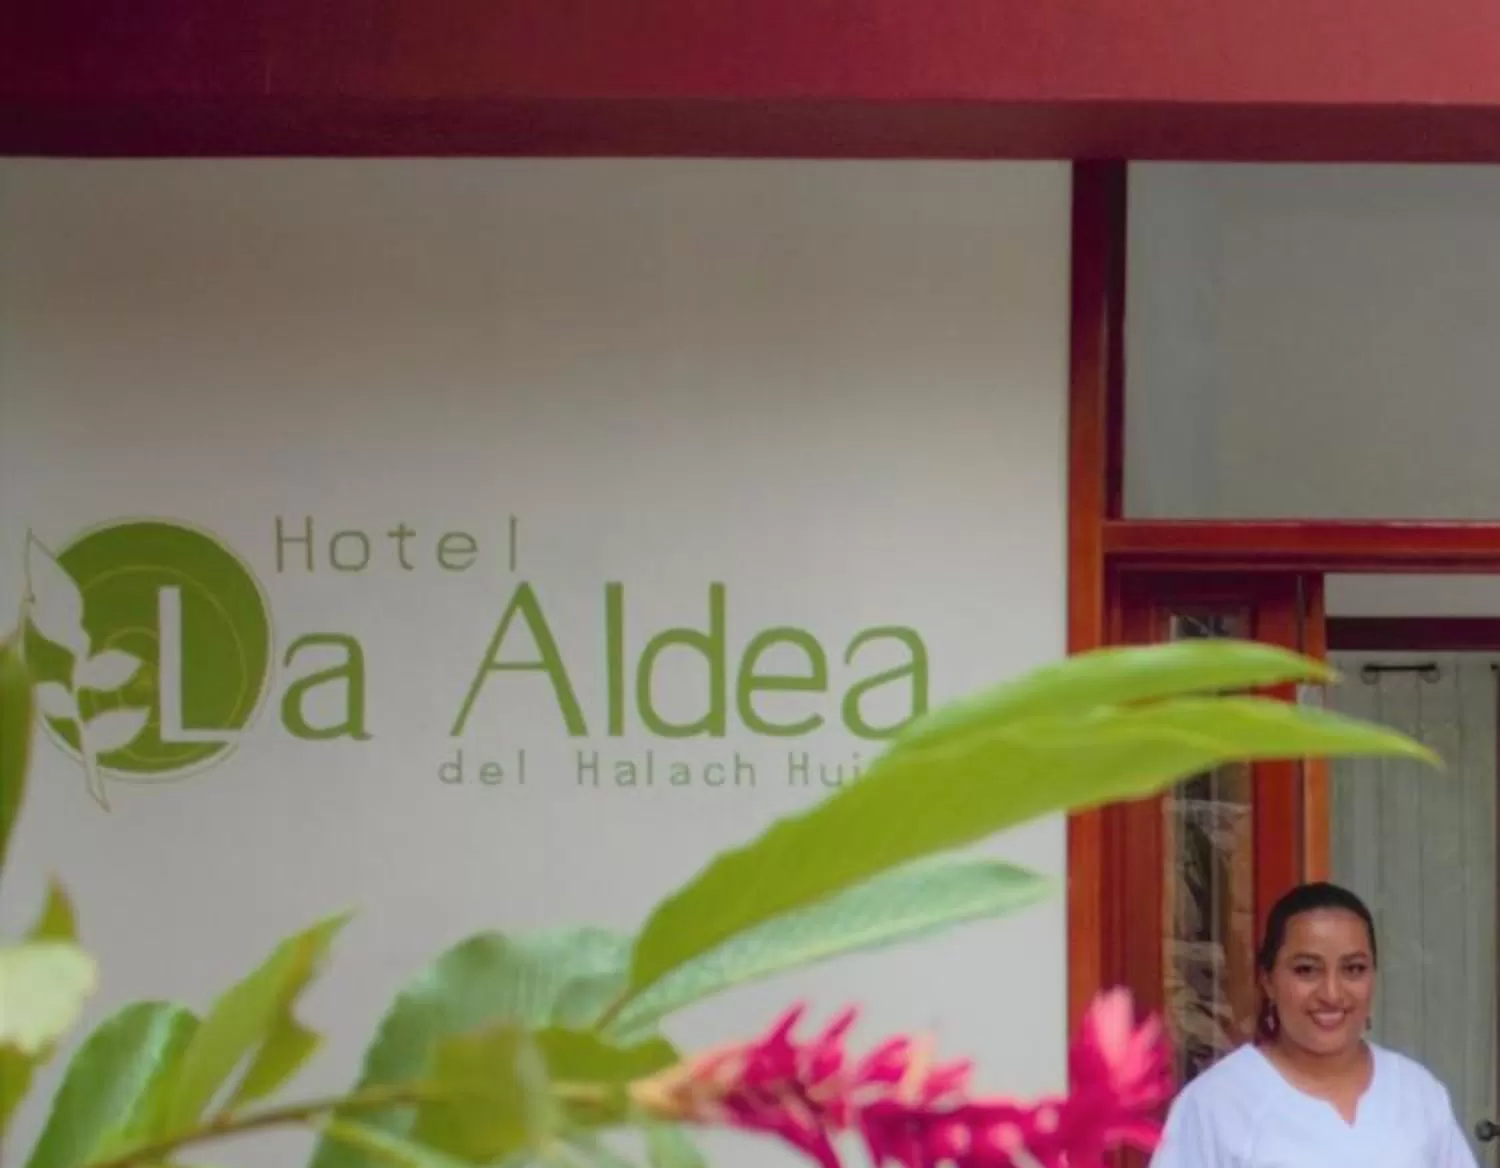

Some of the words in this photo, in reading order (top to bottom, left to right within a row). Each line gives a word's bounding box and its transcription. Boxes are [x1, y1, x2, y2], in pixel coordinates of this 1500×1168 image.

[276, 514, 521, 574] Hotel
[158, 584, 374, 743] La
[449, 580, 930, 739] Aldea
[437, 750, 526, 786] del
[575, 750, 757, 788] Halach
[787, 751, 863, 787] Hui
